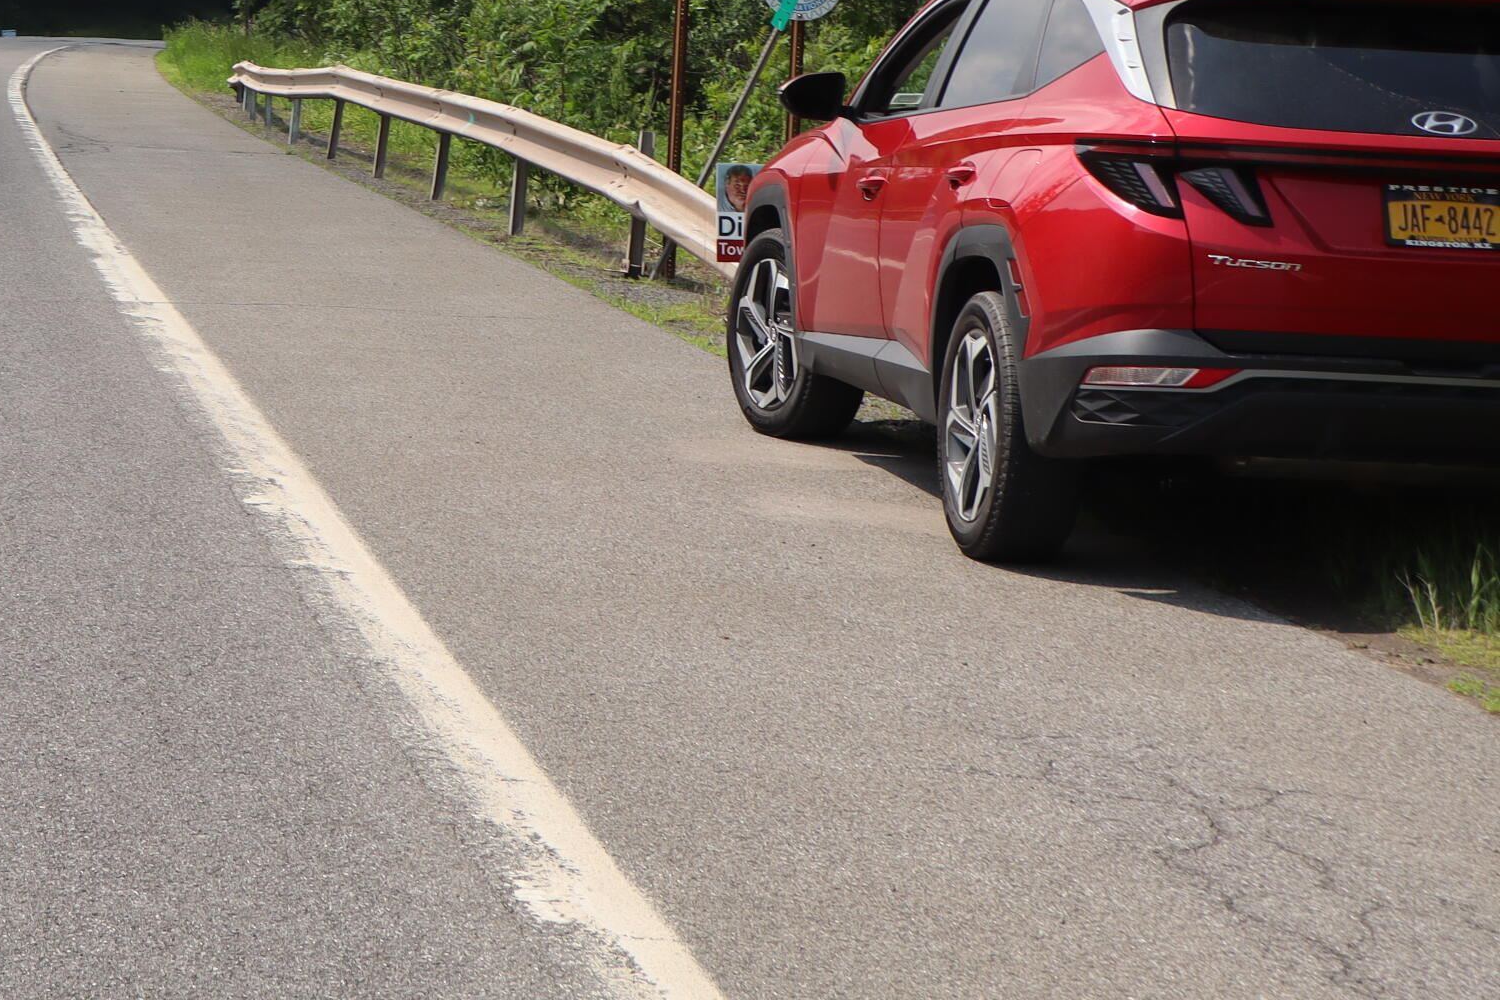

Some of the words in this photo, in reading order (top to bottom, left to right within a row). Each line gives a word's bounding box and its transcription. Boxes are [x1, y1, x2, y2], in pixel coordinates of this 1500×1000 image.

[1388, 184, 1499, 195] PRESTIGE
[1413, 191, 1440, 200] NEW
[1444, 192, 1476, 203] YORK
[1398, 203, 1432, 233] JAF
[1447, 206, 1496, 236] 8442
